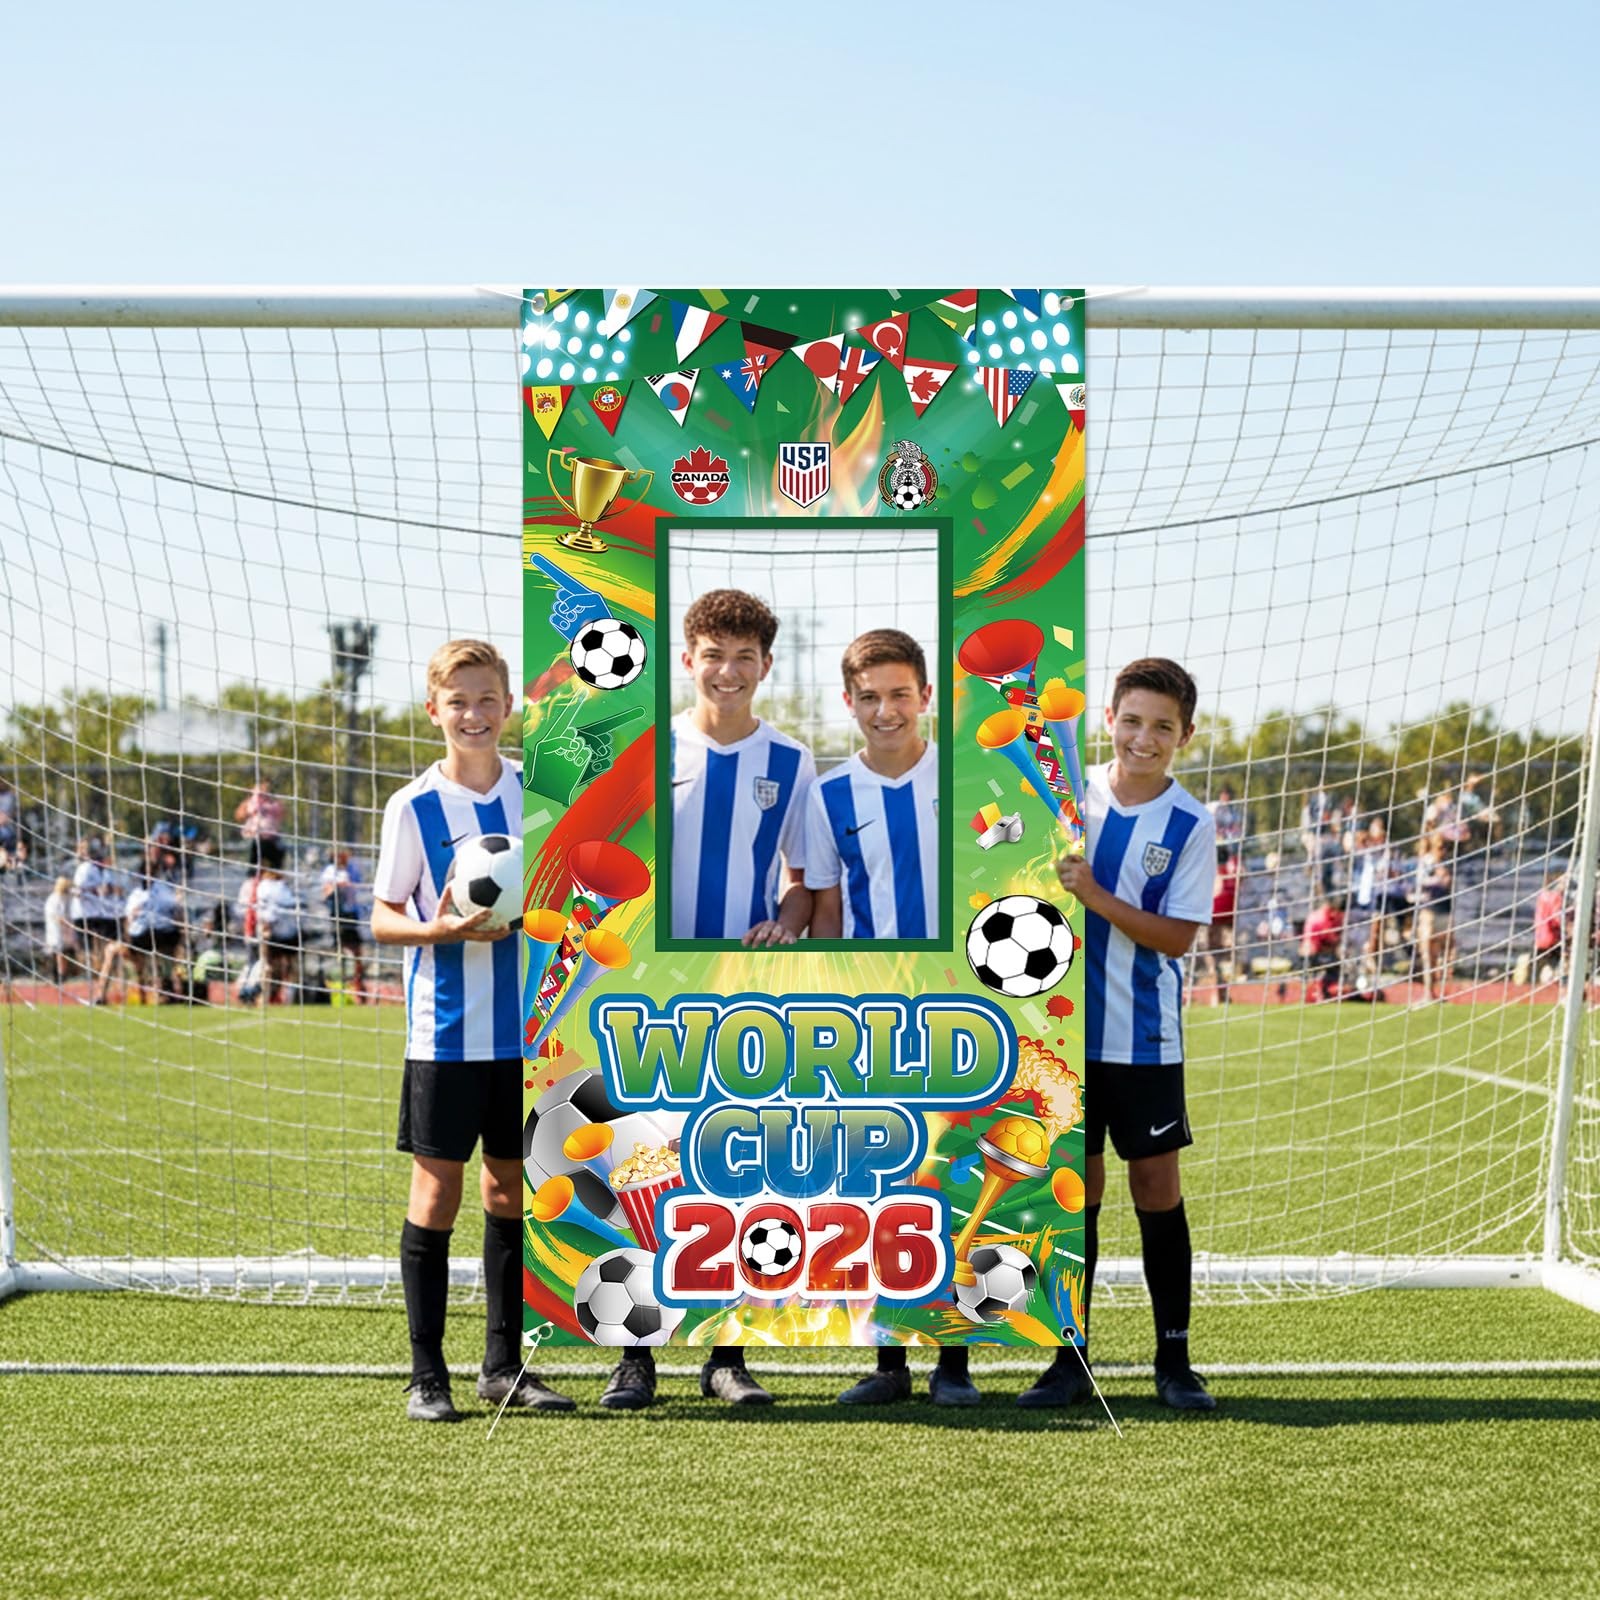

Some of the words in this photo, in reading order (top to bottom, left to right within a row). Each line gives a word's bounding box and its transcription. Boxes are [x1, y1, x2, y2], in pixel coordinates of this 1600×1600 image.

[671, 472, 731, 483] CANADA
[782, 446, 827, 471] USA
[604, 1006, 1004, 1098] WORLD
[701, 1104, 914, 1197] CUP
[671, 1202, 938, 1292] 2026
